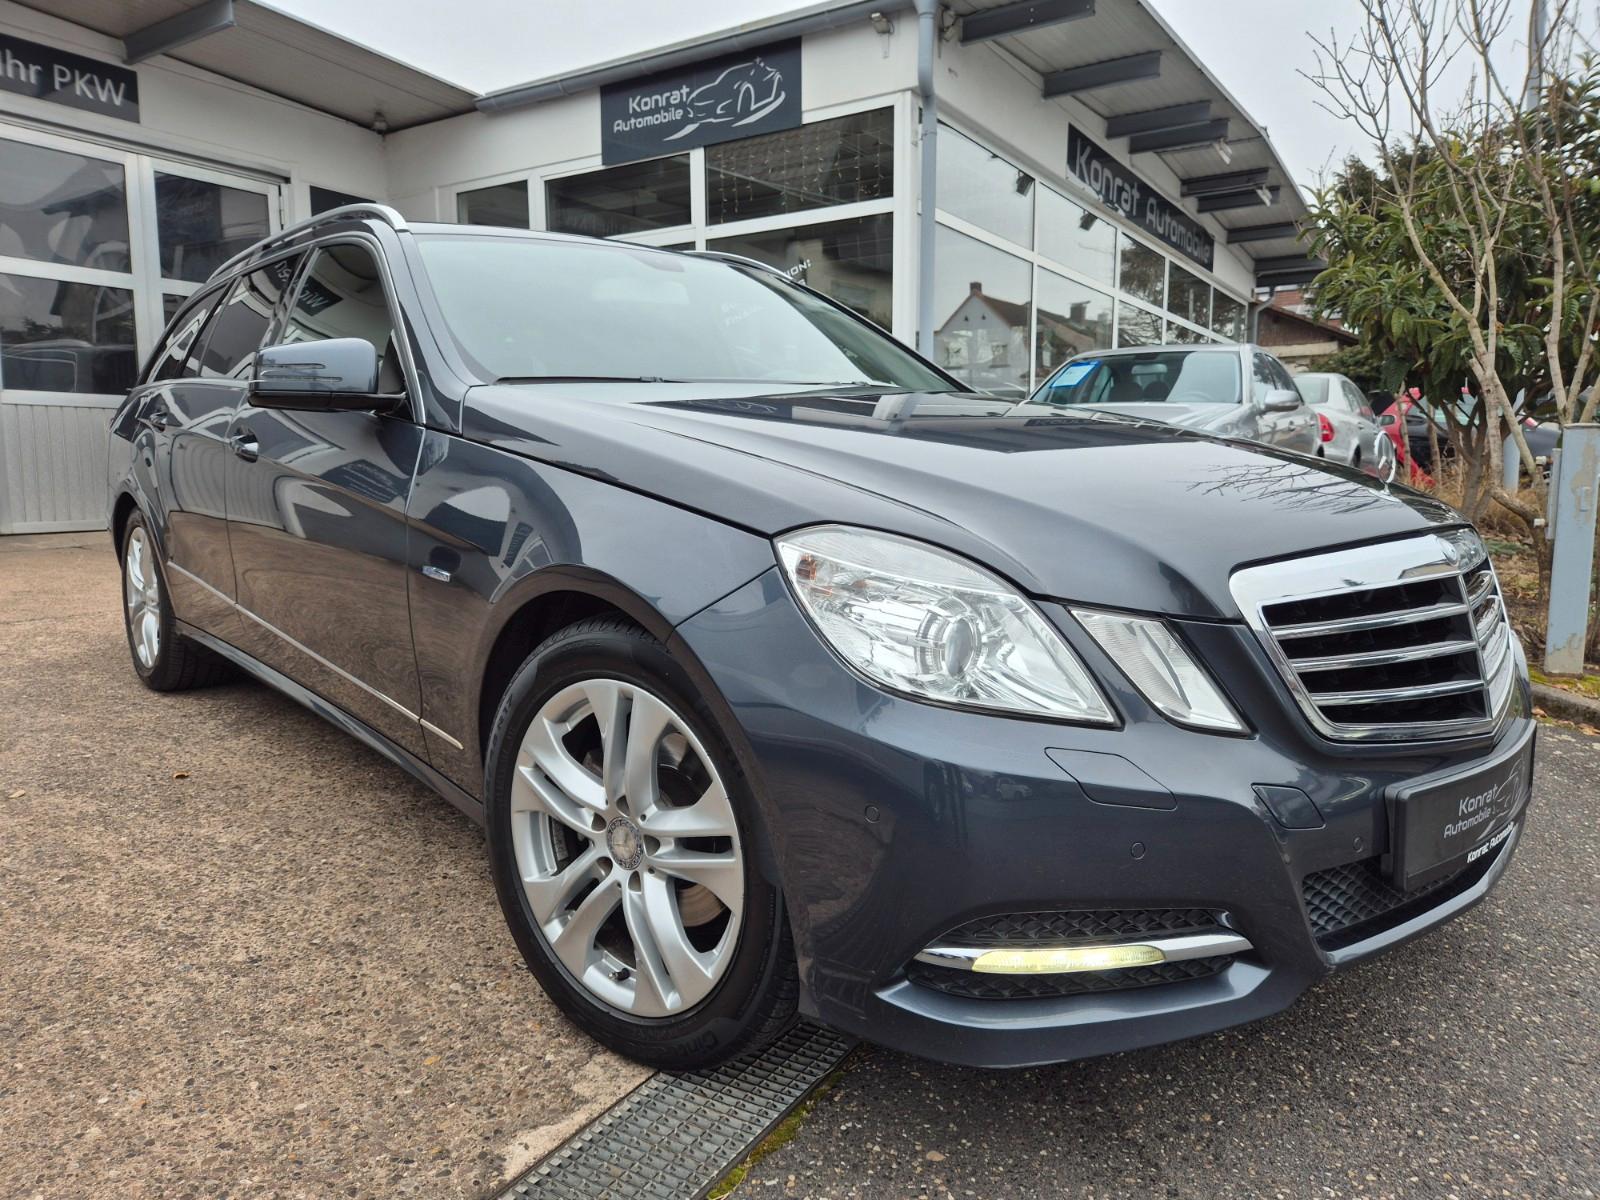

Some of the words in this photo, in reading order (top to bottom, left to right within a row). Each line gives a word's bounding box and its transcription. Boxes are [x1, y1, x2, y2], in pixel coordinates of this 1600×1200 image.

[53, 64, 126, 106] PKW
[628, 84, 690, 114] Konrat
[613, 107, 684, 134] Automobile
[1075, 138, 1140, 216] Konrat
[1146, 197, 1211, 263] Automobile
[1458, 784, 1498, 816] Konrat
[1443, 805, 1492, 838] Automobile
